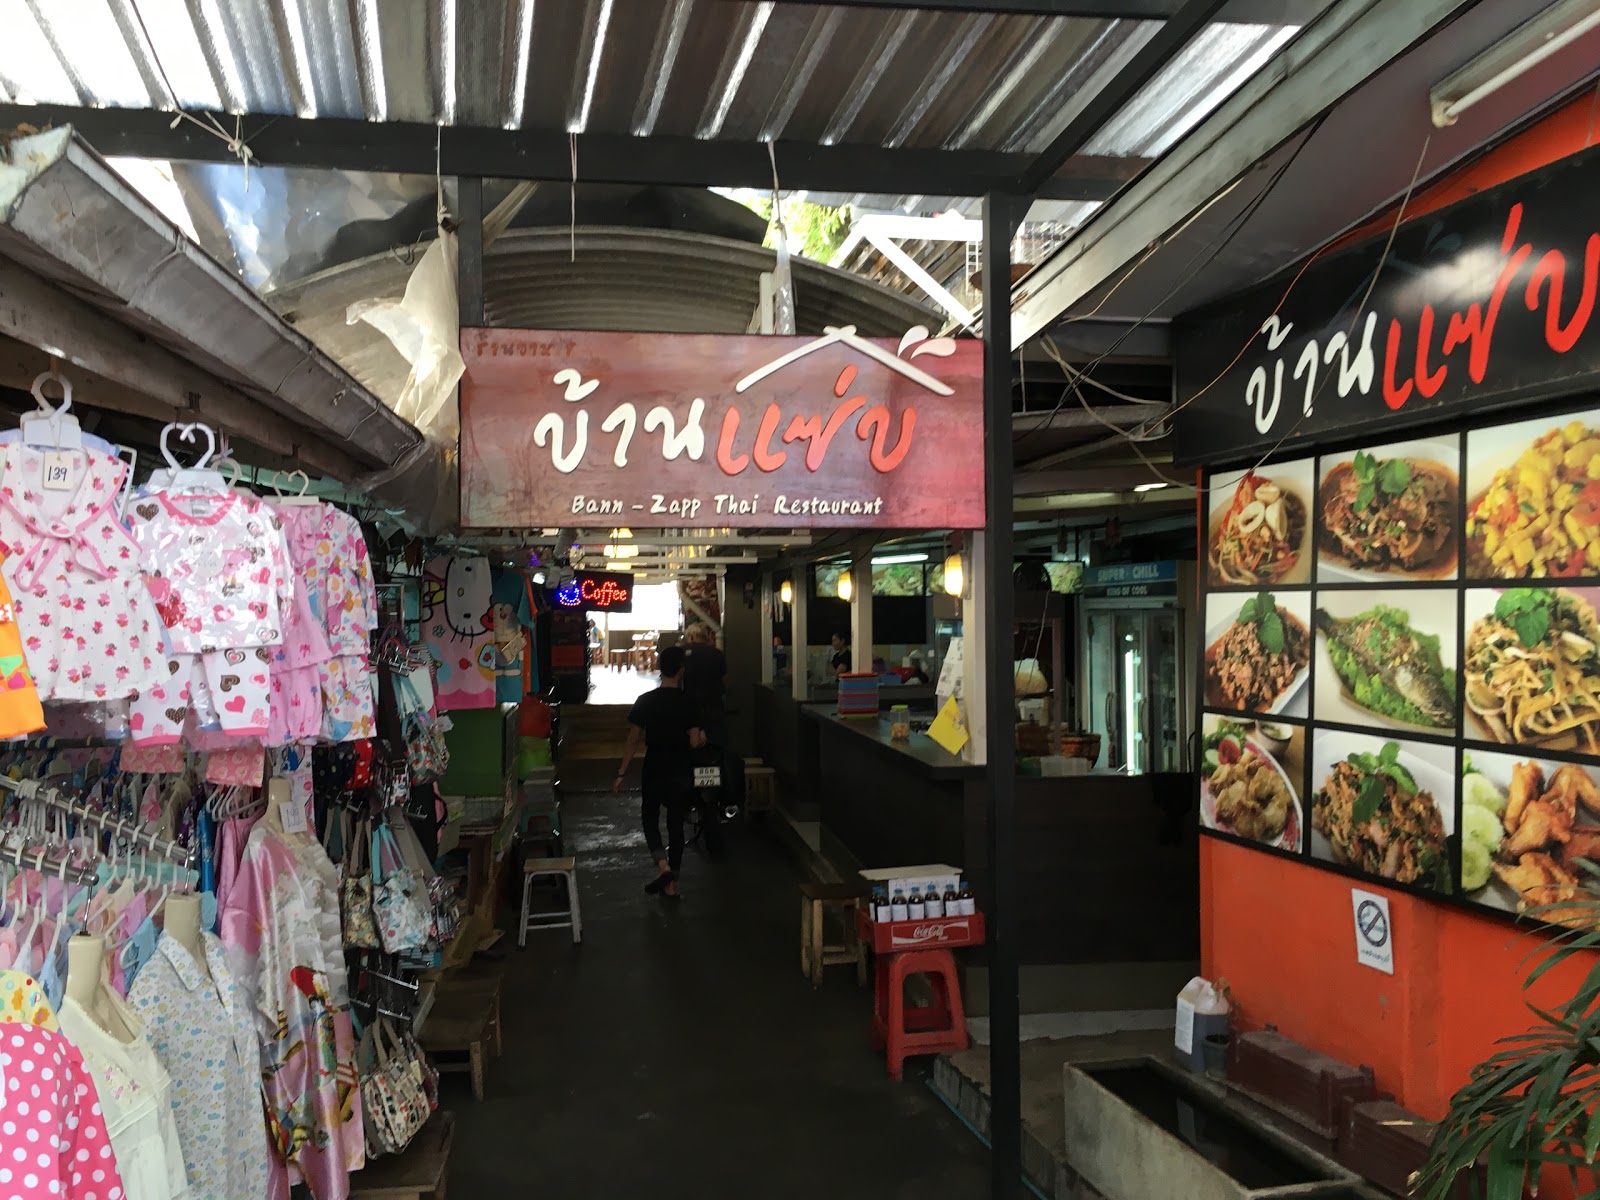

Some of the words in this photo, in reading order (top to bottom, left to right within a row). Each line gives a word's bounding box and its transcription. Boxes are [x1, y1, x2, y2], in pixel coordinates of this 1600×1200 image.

[47, 465, 68, 482] 139
[571, 495, 623, 515] Bann
[650, 494, 702, 519] Zapp
[714, 494, 760, 515] Thai
[773, 496, 884, 516] Restaurant
[1132, 564, 1159, 578] CHILL
[581, 579, 627, 606] Coffee
